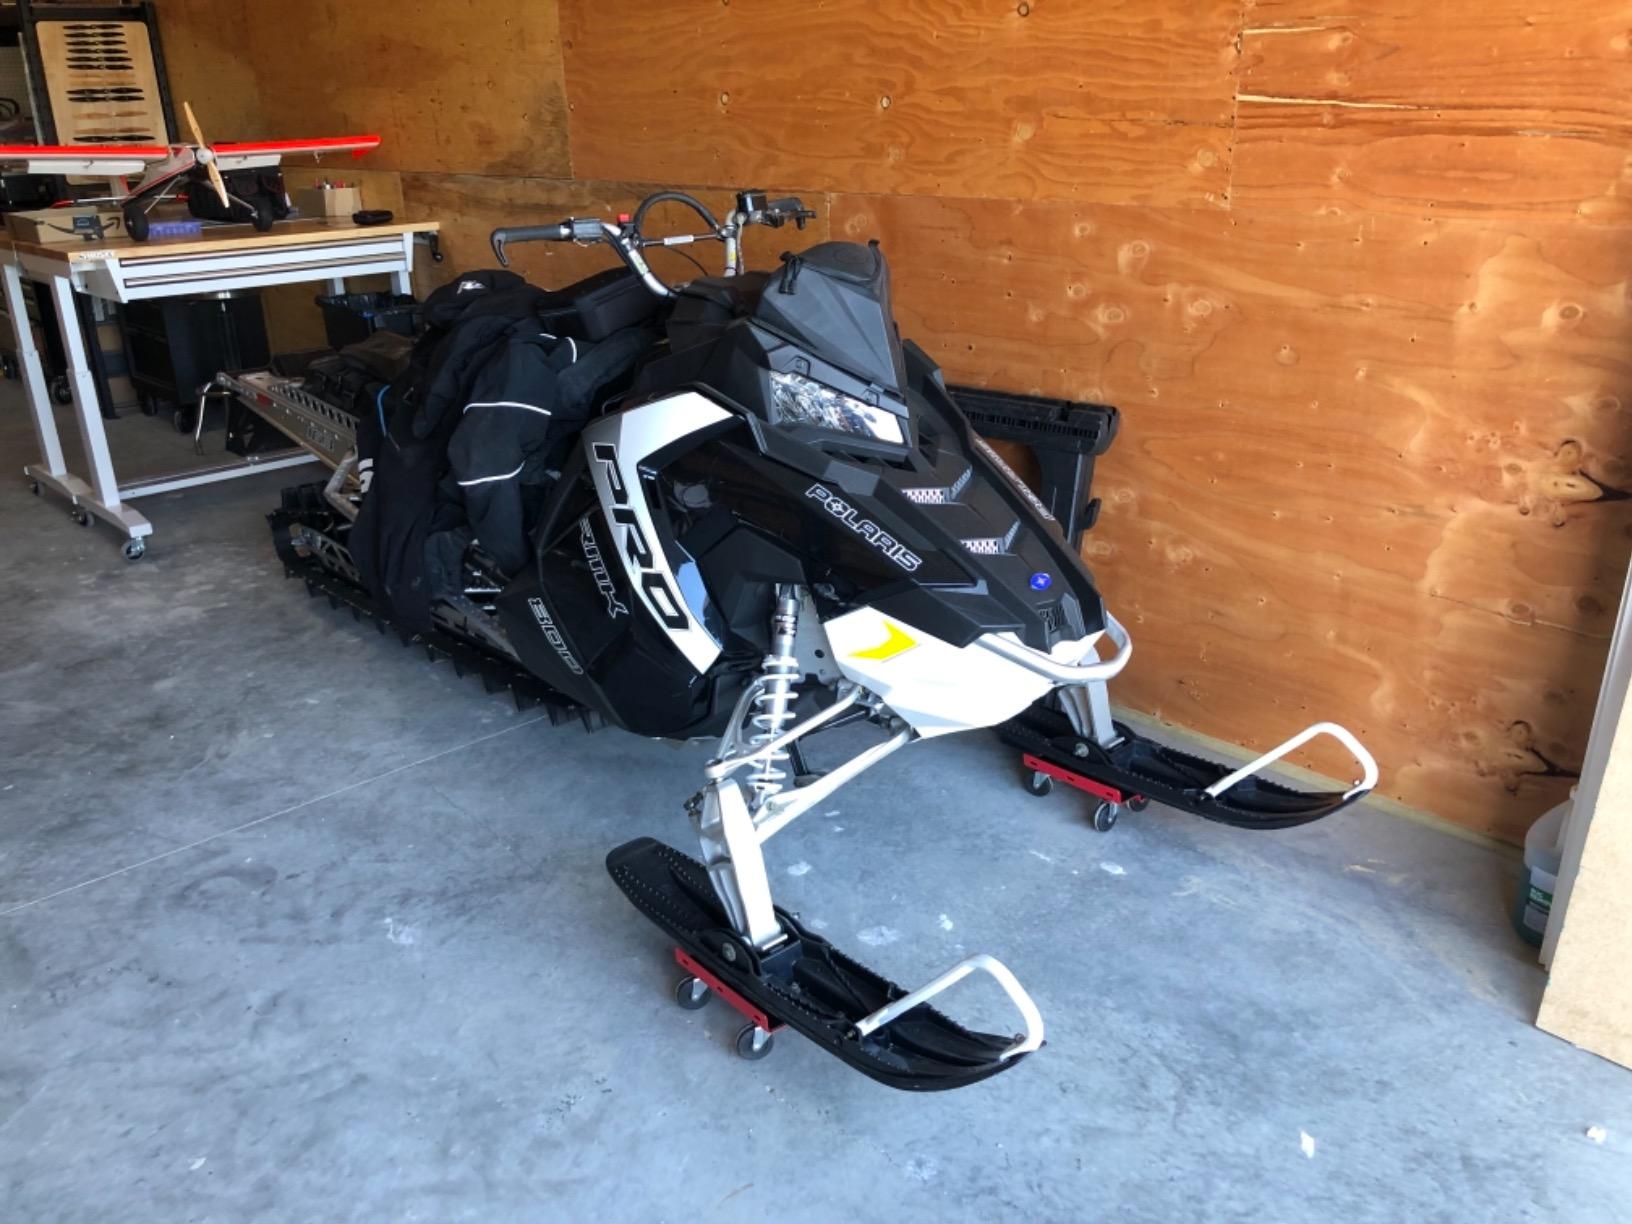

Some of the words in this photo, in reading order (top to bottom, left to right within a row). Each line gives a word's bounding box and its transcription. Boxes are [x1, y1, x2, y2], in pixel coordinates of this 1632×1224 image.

[592, 442, 690, 631] PRO
[804, 482, 923, 572] POLARIS
[527, 597, 584, 675] 800
